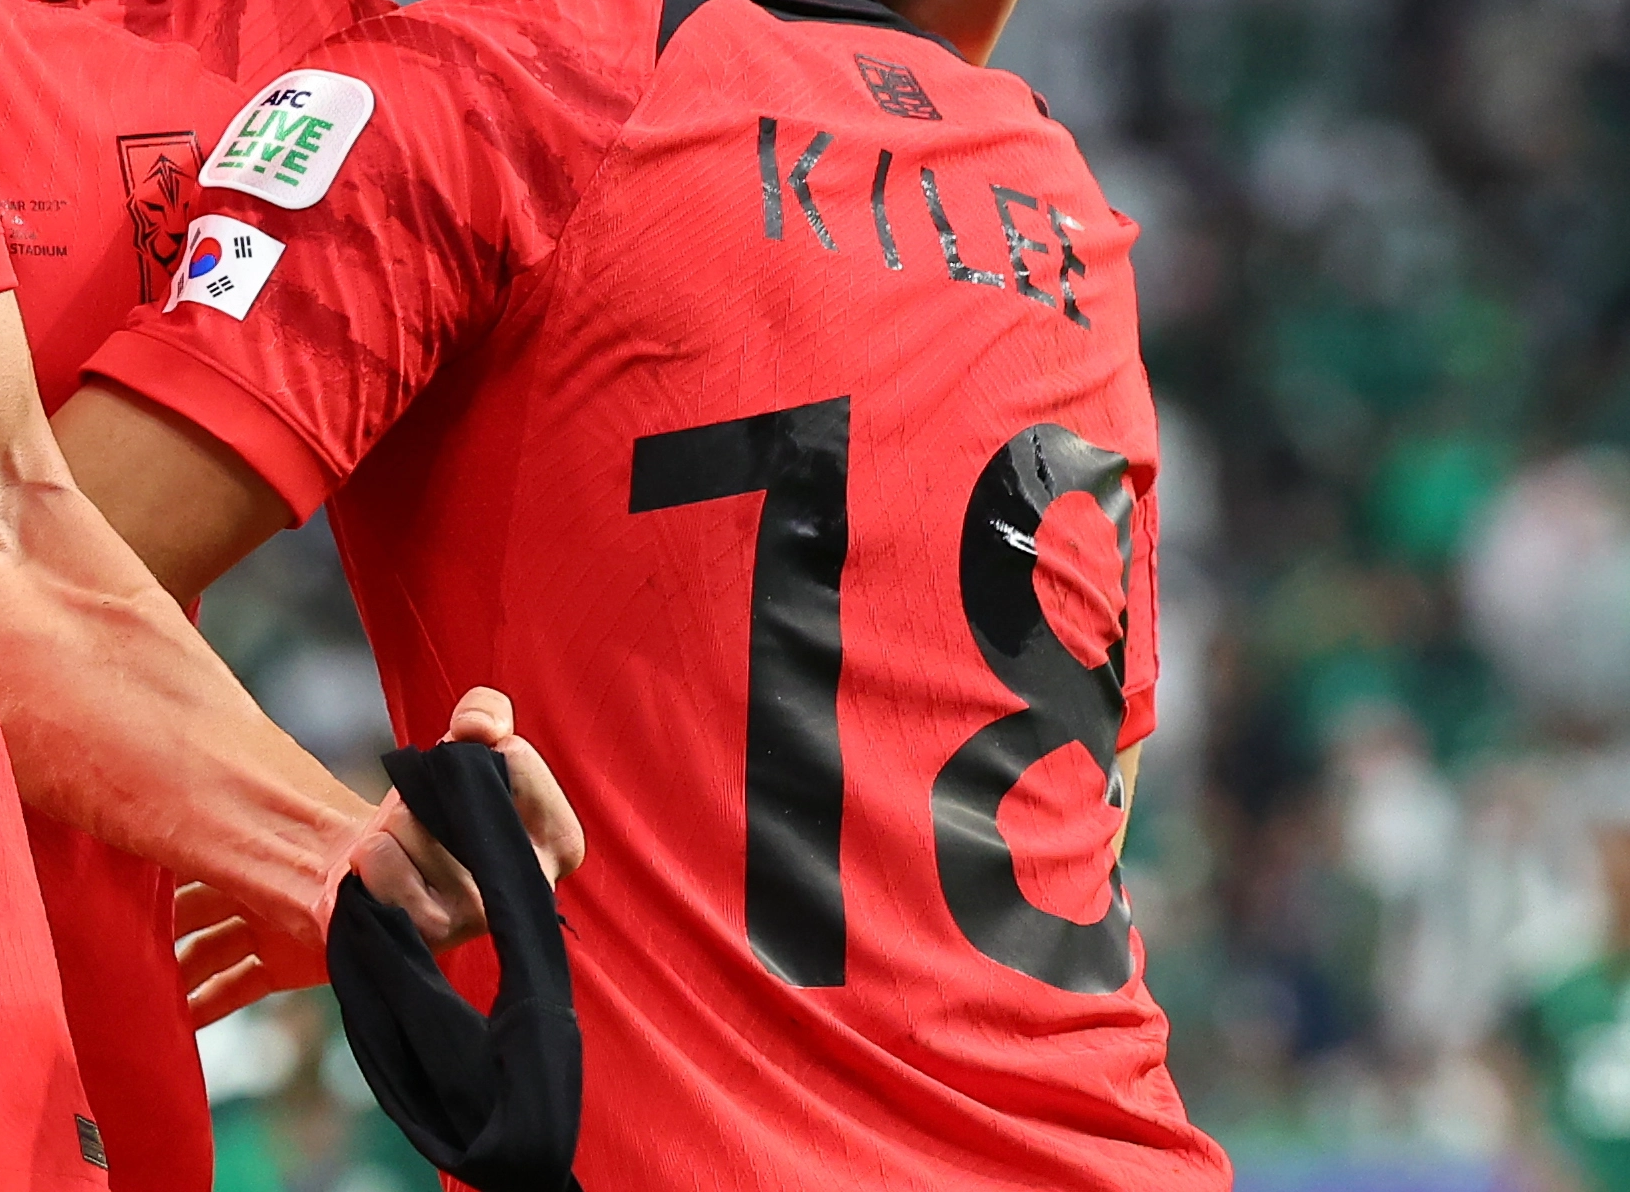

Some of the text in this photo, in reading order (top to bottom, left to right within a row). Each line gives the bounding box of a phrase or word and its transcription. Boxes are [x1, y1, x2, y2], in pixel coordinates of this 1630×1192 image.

[260, 90, 312, 108] AFC
[238, 110, 334, 153] LIVE
[10, 243, 68, 256] STADIUM
[629, 395, 1134, 996] 18
